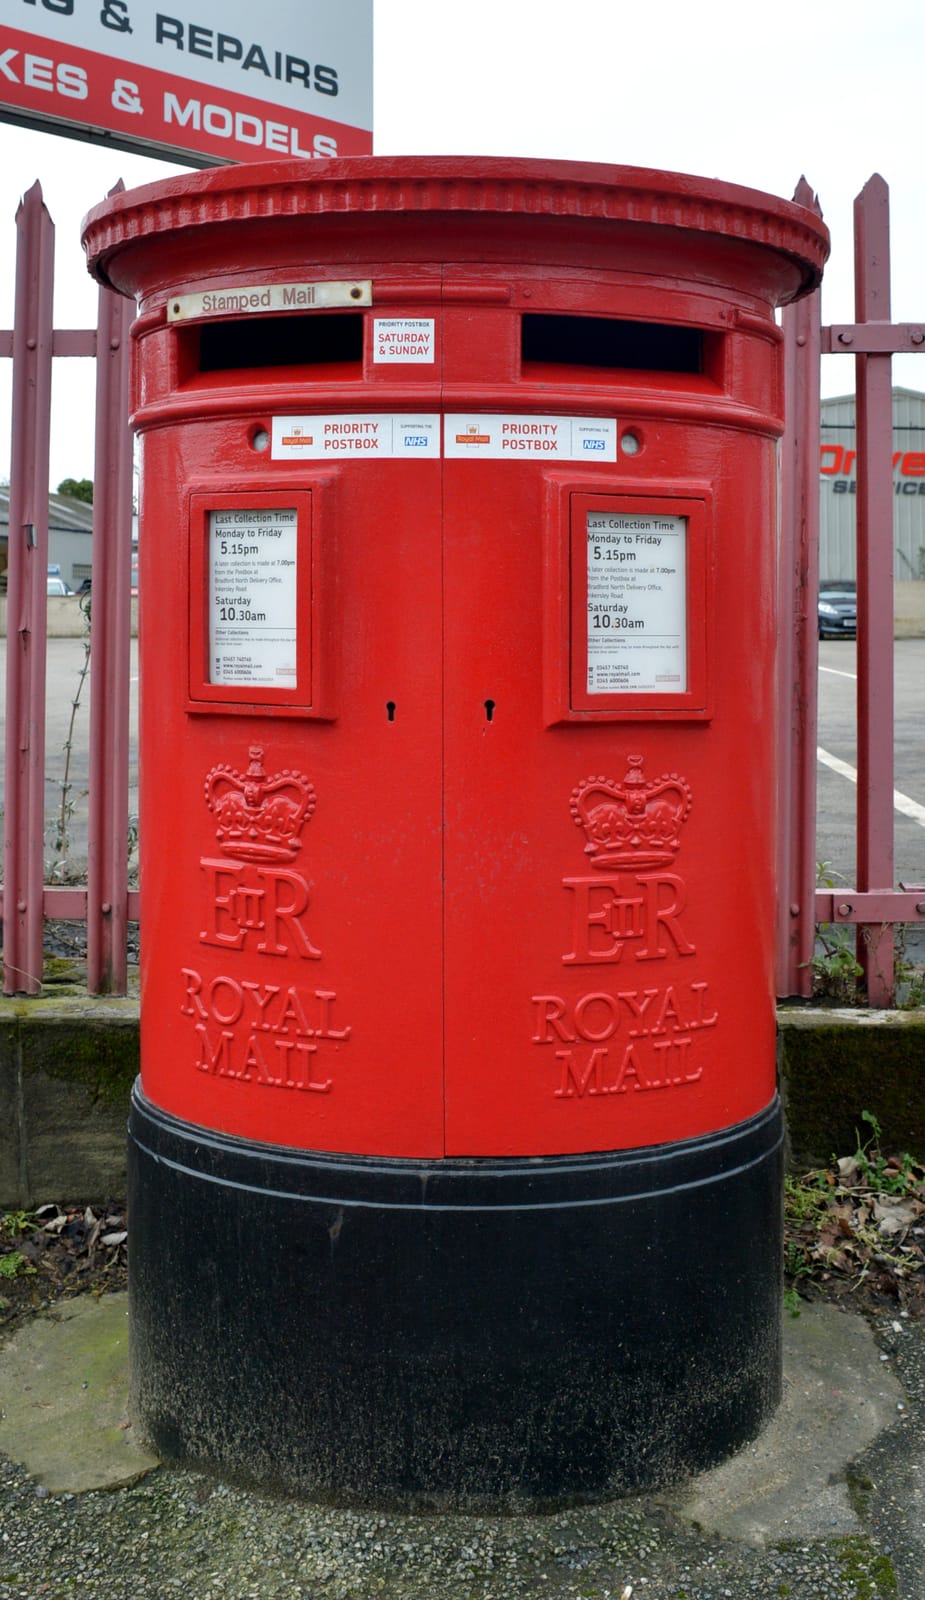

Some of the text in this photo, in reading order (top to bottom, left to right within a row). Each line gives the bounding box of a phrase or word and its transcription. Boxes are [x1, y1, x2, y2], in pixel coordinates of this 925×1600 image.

[101, 0, 339, 97] & REPAIRS
[111, 78, 143, 115] &
[164, 93, 338, 159] MODELS
[202, 287, 315, 313] Stamped Mail
[378, 333, 430, 343] SATURDAY
[379, 345, 429, 355] & SUNDAY
[324, 423, 379, 434] PRIORITY
[502, 423, 558, 435] PRIORITY
[324, 438, 379, 450] POSTBOX
[405, 437, 427, 446] NHS
[502, 439, 558, 451] POSTBOX
[583, 440, 605, 449] NHS
[215, 513, 294, 524] Last Collection Time
[587, 519, 675, 530] Last Collection Time
[215, 529, 245, 539] Monday
[258, 528, 283, 538] Friday
[587, 534, 621, 545] Monday
[636, 535, 662, 546] Friday
[221, 541, 259, 557] 5.15pm
[594, 546, 636, 562] 5.15pm
[215, 596, 252, 606] Saturday
[220, 607, 266, 621] 10.30am
[588, 603, 628, 613] Saturday
[593, 614, 644, 628] 10.30am
[180, 967, 352, 1041] ROYAL
[531, 982, 718, 1044] ROYAL
[195, 1024, 333, 1093] MAIL
[554, 1037, 703, 1099] MAIL
